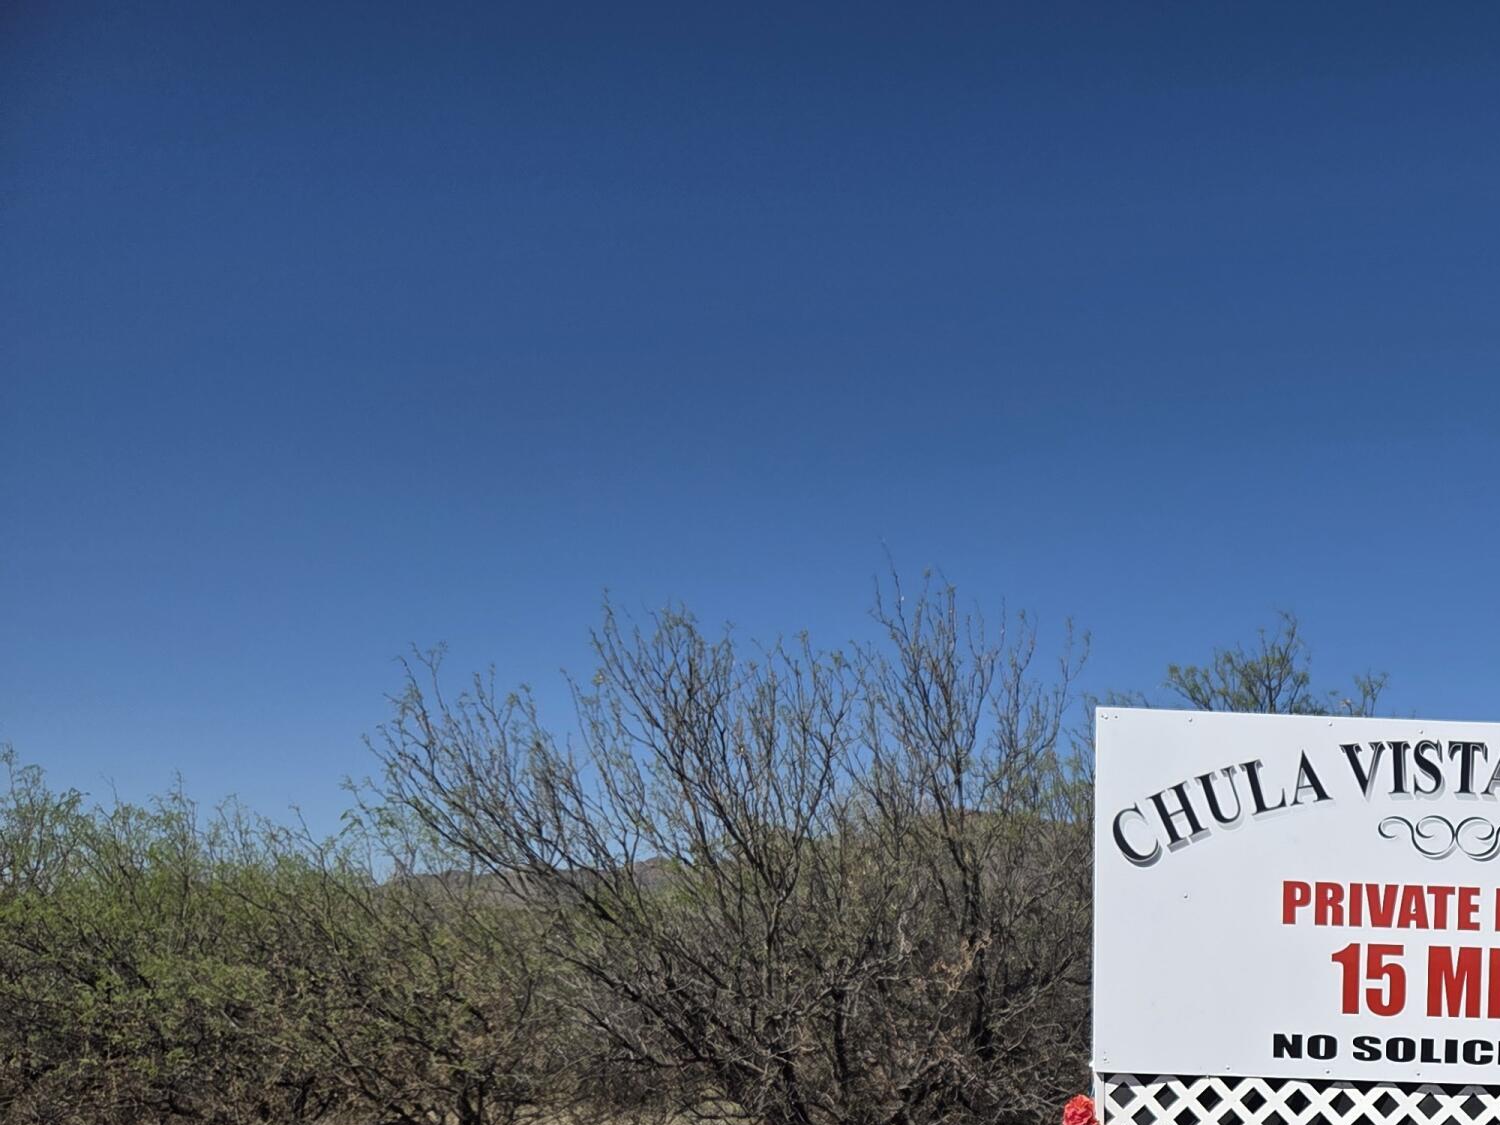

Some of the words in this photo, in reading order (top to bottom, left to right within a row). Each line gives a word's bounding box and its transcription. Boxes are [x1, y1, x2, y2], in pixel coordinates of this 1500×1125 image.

[1112, 749, 1331, 868] CHULA
[1282, 880, 1481, 932] PRIVATE
[1331, 942, 1407, 1017] 15
[1272, 1033, 1338, 1061] NO
